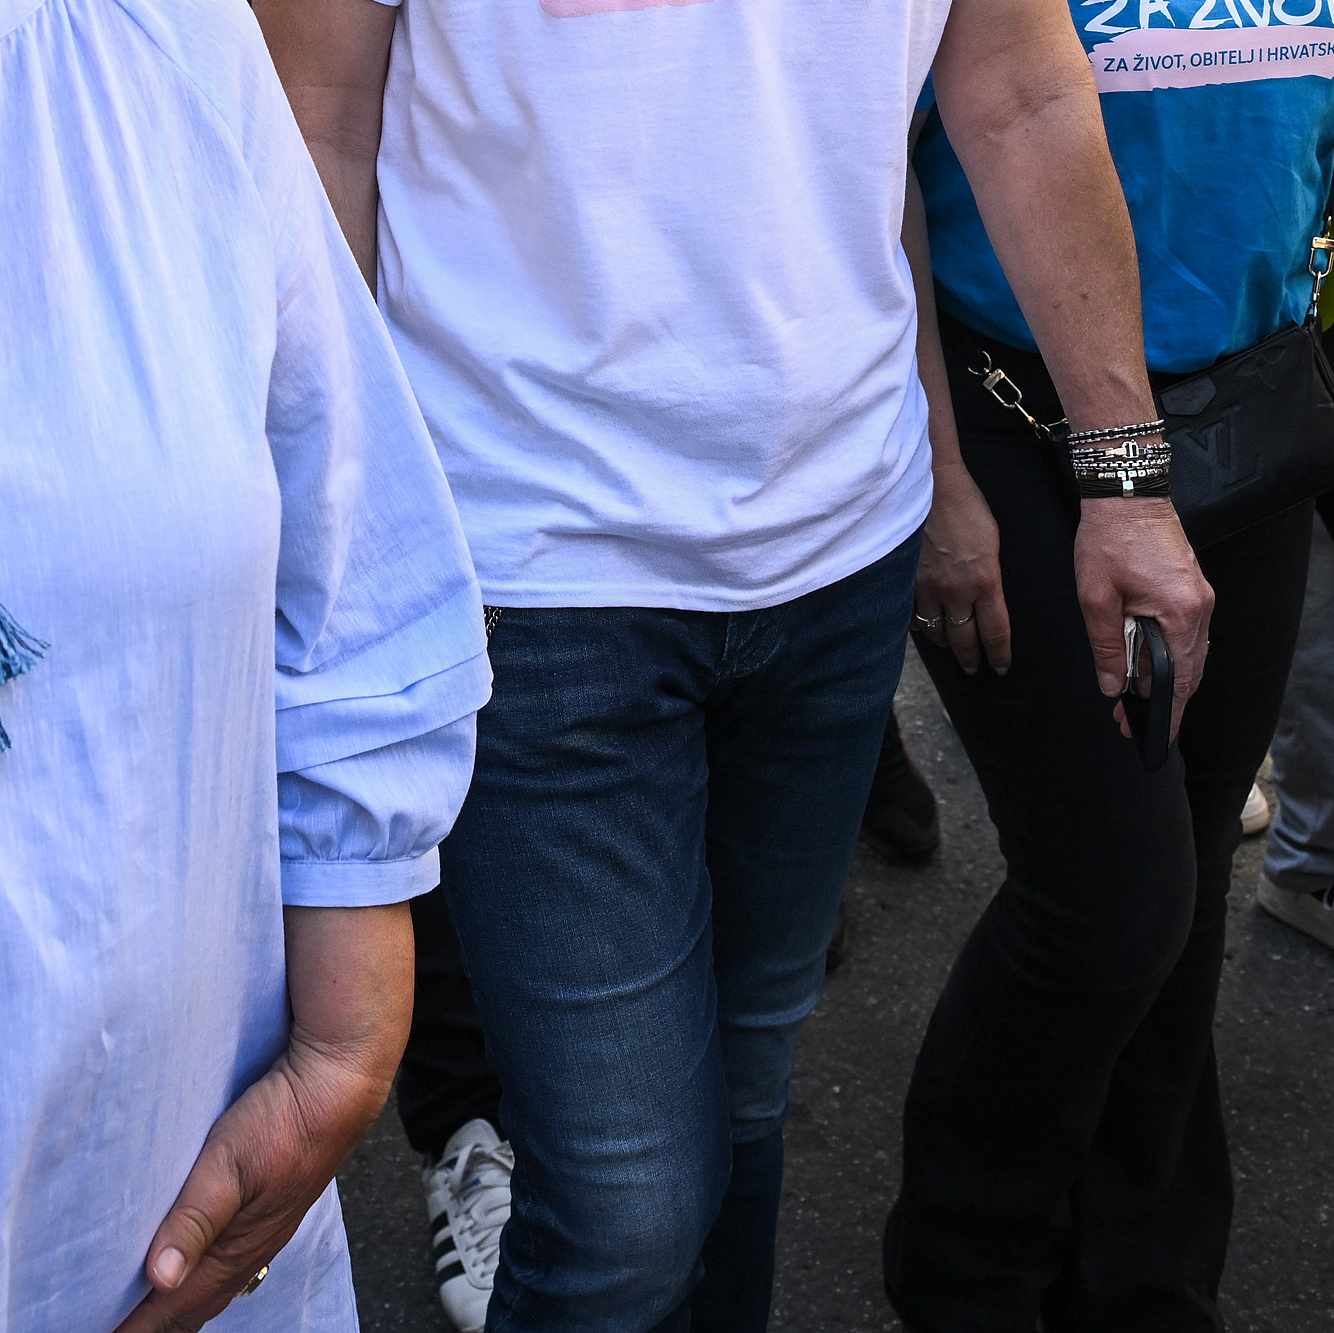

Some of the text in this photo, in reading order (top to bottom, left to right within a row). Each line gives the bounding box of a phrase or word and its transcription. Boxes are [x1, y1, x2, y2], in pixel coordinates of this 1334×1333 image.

[1103, 57, 1129, 73] ZA
[1132, 52, 1187, 73] ŽIVOT,
[1190, 50, 1256, 68] OBITELJ
[1258, 49, 1263, 63] I
